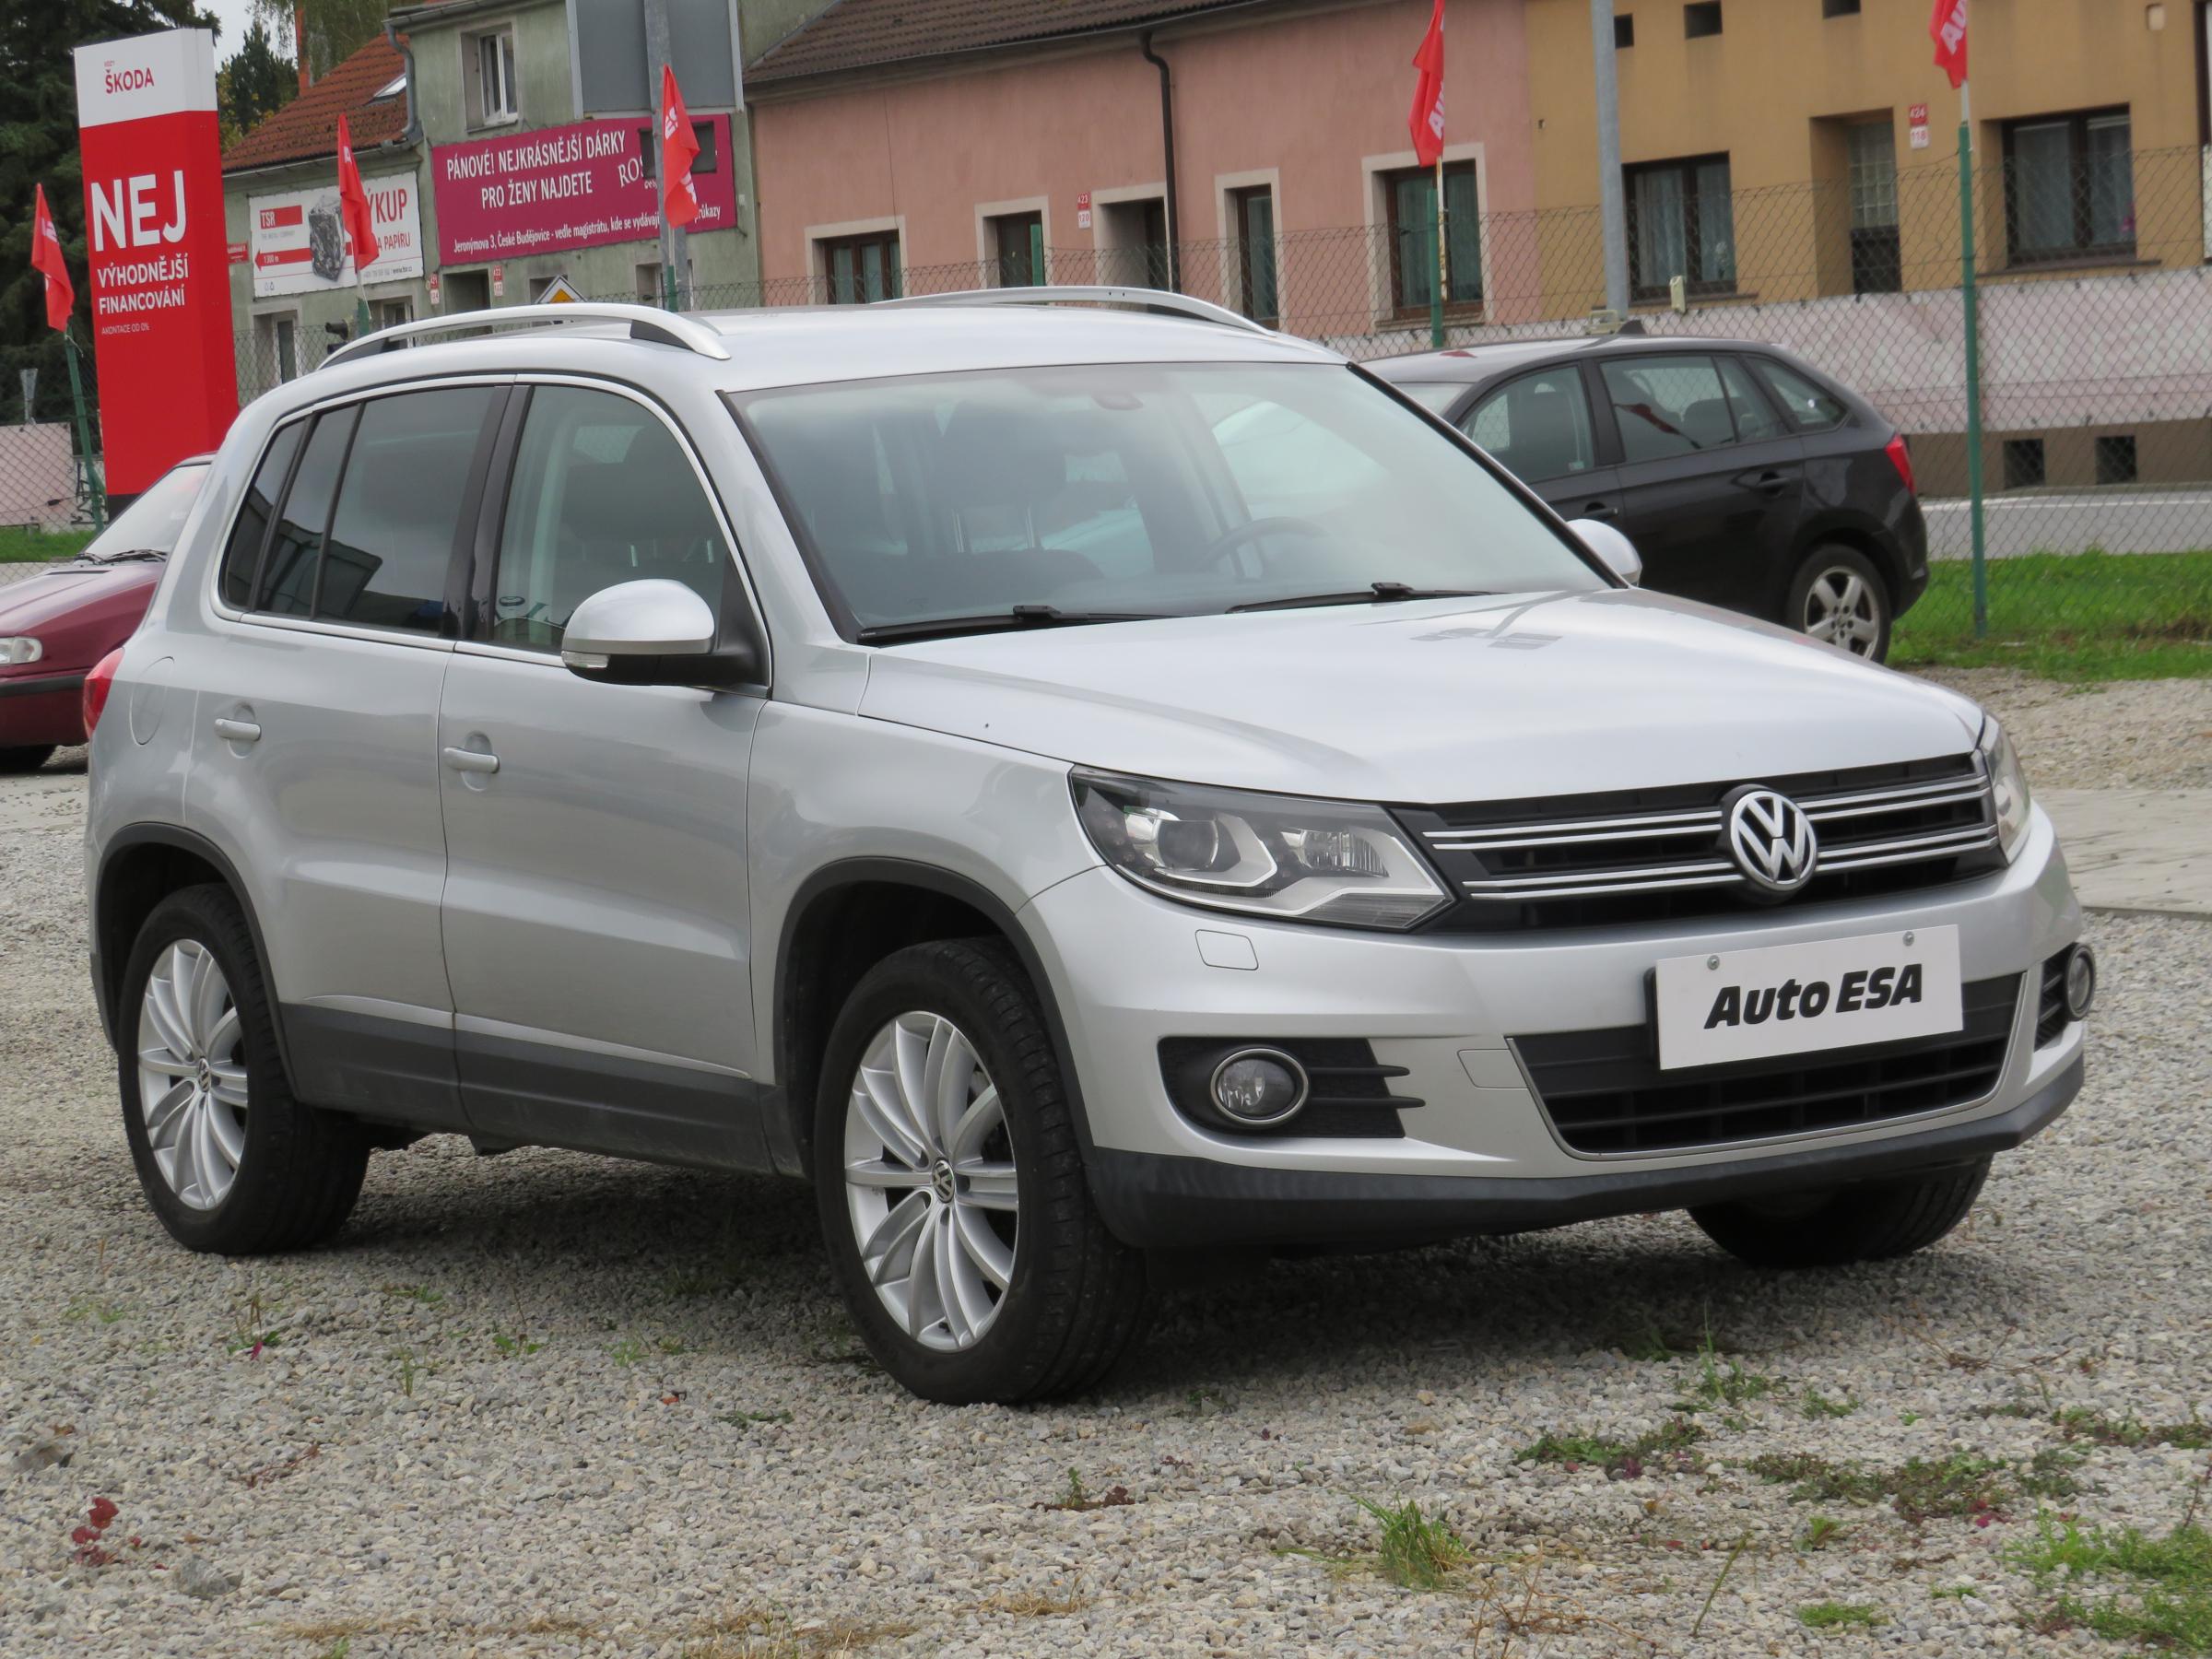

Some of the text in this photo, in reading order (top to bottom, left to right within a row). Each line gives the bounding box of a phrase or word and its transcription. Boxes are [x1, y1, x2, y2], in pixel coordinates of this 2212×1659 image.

[104, 67, 155, 94] ŠKODA
[447, 129, 626, 181] PÁNOVÉ! NEJKRÁSNĚJŠÍ DÁRKY
[481, 171, 593, 210] PRO ŽENY NAJDETE
[90, 170, 187, 253] NEJ
[261, 211, 276, 227] TSR
[383, 230, 411, 251] PAPÍRU
[453, 236, 489, 254] Jeronýmova
[497, 229, 516, 248] České
[516, 227, 550, 247] Budějovice
[555, 224, 572, 239] vedle
[573, 218, 610, 241] magistrátu,
[610, 216, 623, 231] kde
[624, 218, 632, 229] se
[97, 253, 189, 288] VÝHODNĚJŠÍ
[99, 284, 186, 315] FINANCOVÁNÍ
[102, 324, 131, 335] AKONTACE
[132, 323, 140, 332] OD
[1703, 963, 1923, 1030] Auto ESA
